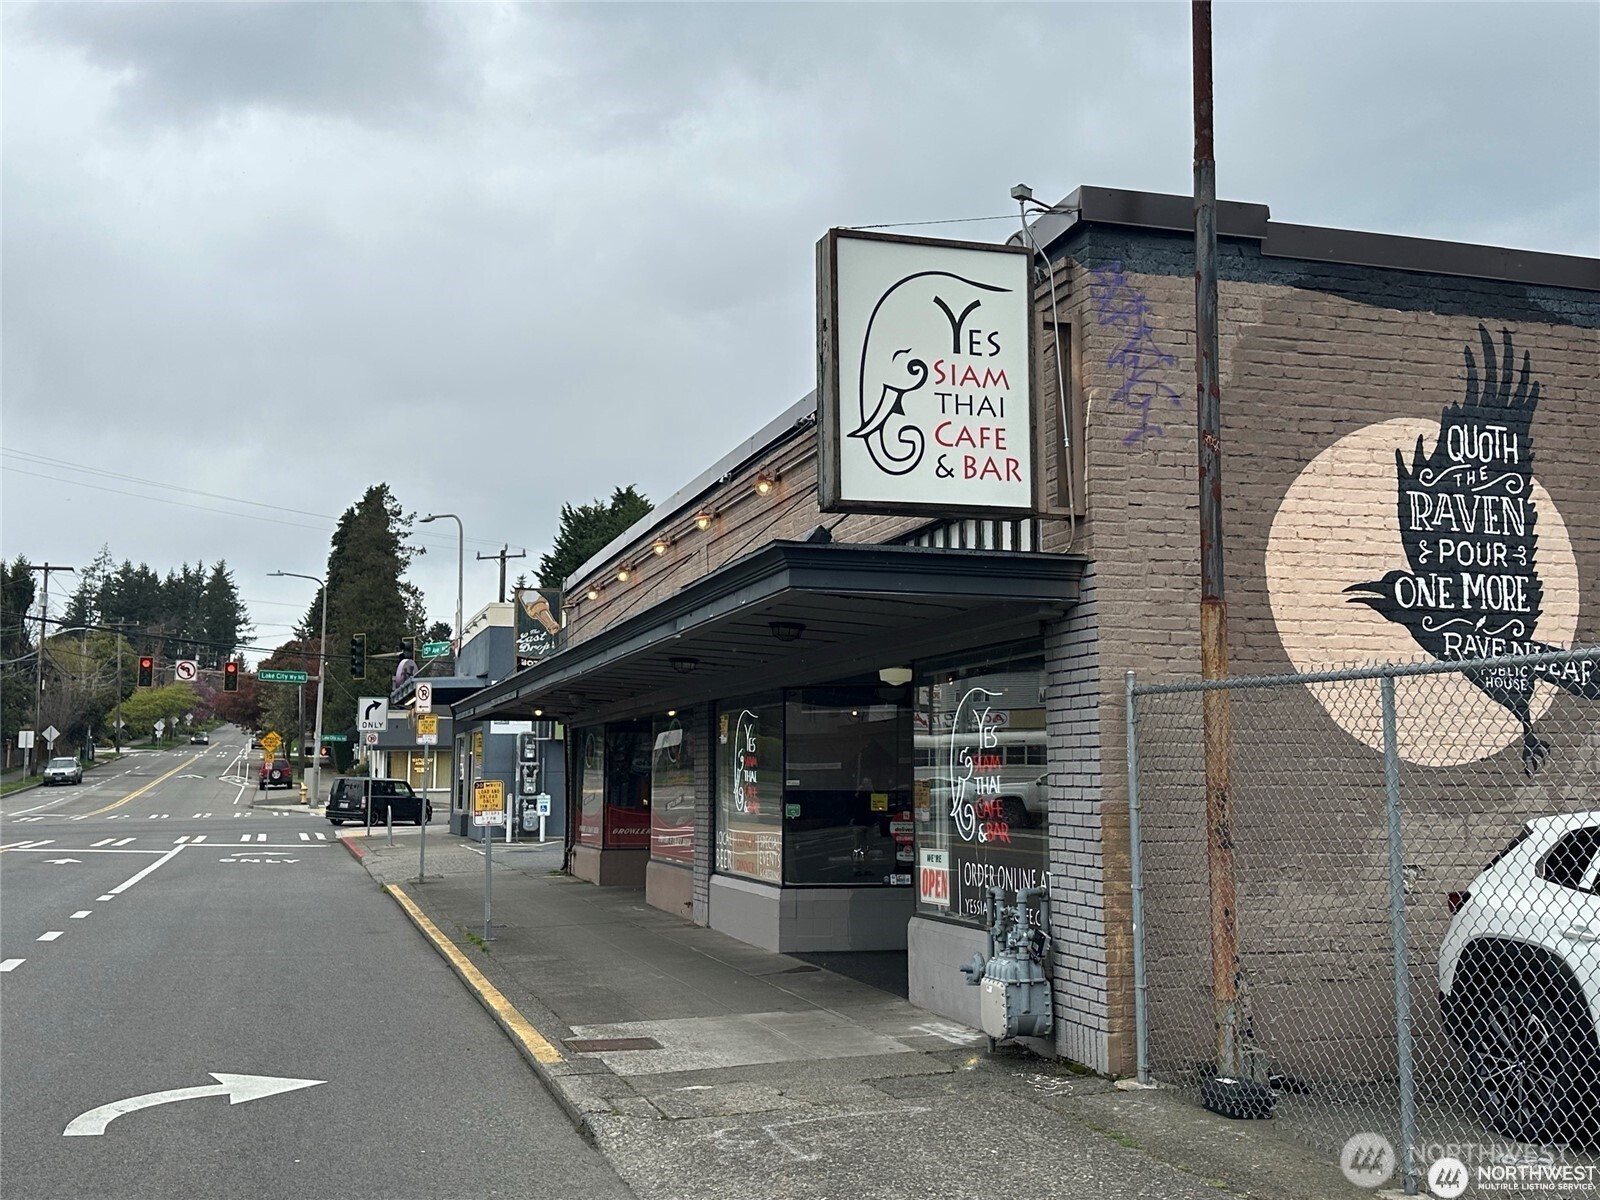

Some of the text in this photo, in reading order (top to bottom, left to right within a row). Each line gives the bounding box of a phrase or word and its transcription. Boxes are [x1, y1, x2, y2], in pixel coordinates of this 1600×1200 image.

[932, 295, 1001, 357] YES
[933, 359, 1010, 391] SIAM
[934, 392, 1005, 418] THAI
[934, 420, 1007, 450] CAFE
[1447, 424, 1519, 464] QUOTH
[935, 453, 1022, 482] & BAR
[1453, 466, 1488, 487] THE
[1406, 491, 1525, 537] RAVEN
[1439, 539, 1508, 567] POUR
[1394, 572, 1531, 612] ONE MORE
[516, 631, 547, 644] Last
[518, 642, 550, 655] Drop
[1485, 677, 1528, 691] HOUSE
[362, 721, 384, 729] ONLY
[973, 706, 998, 749] YES
[974, 775, 1001, 795] THAI
[975, 797, 1003, 819] CAFE
[716, 830, 733, 846] LOCAL
[978, 822, 1011, 844] & BAR
[716, 848, 733, 869] BEER
[926, 854, 942, 863] WE'RE
[922, 868, 948, 900] OPEN
[964, 862, 995, 889] ORDER
[997, 865, 1037, 893] ONLINE
